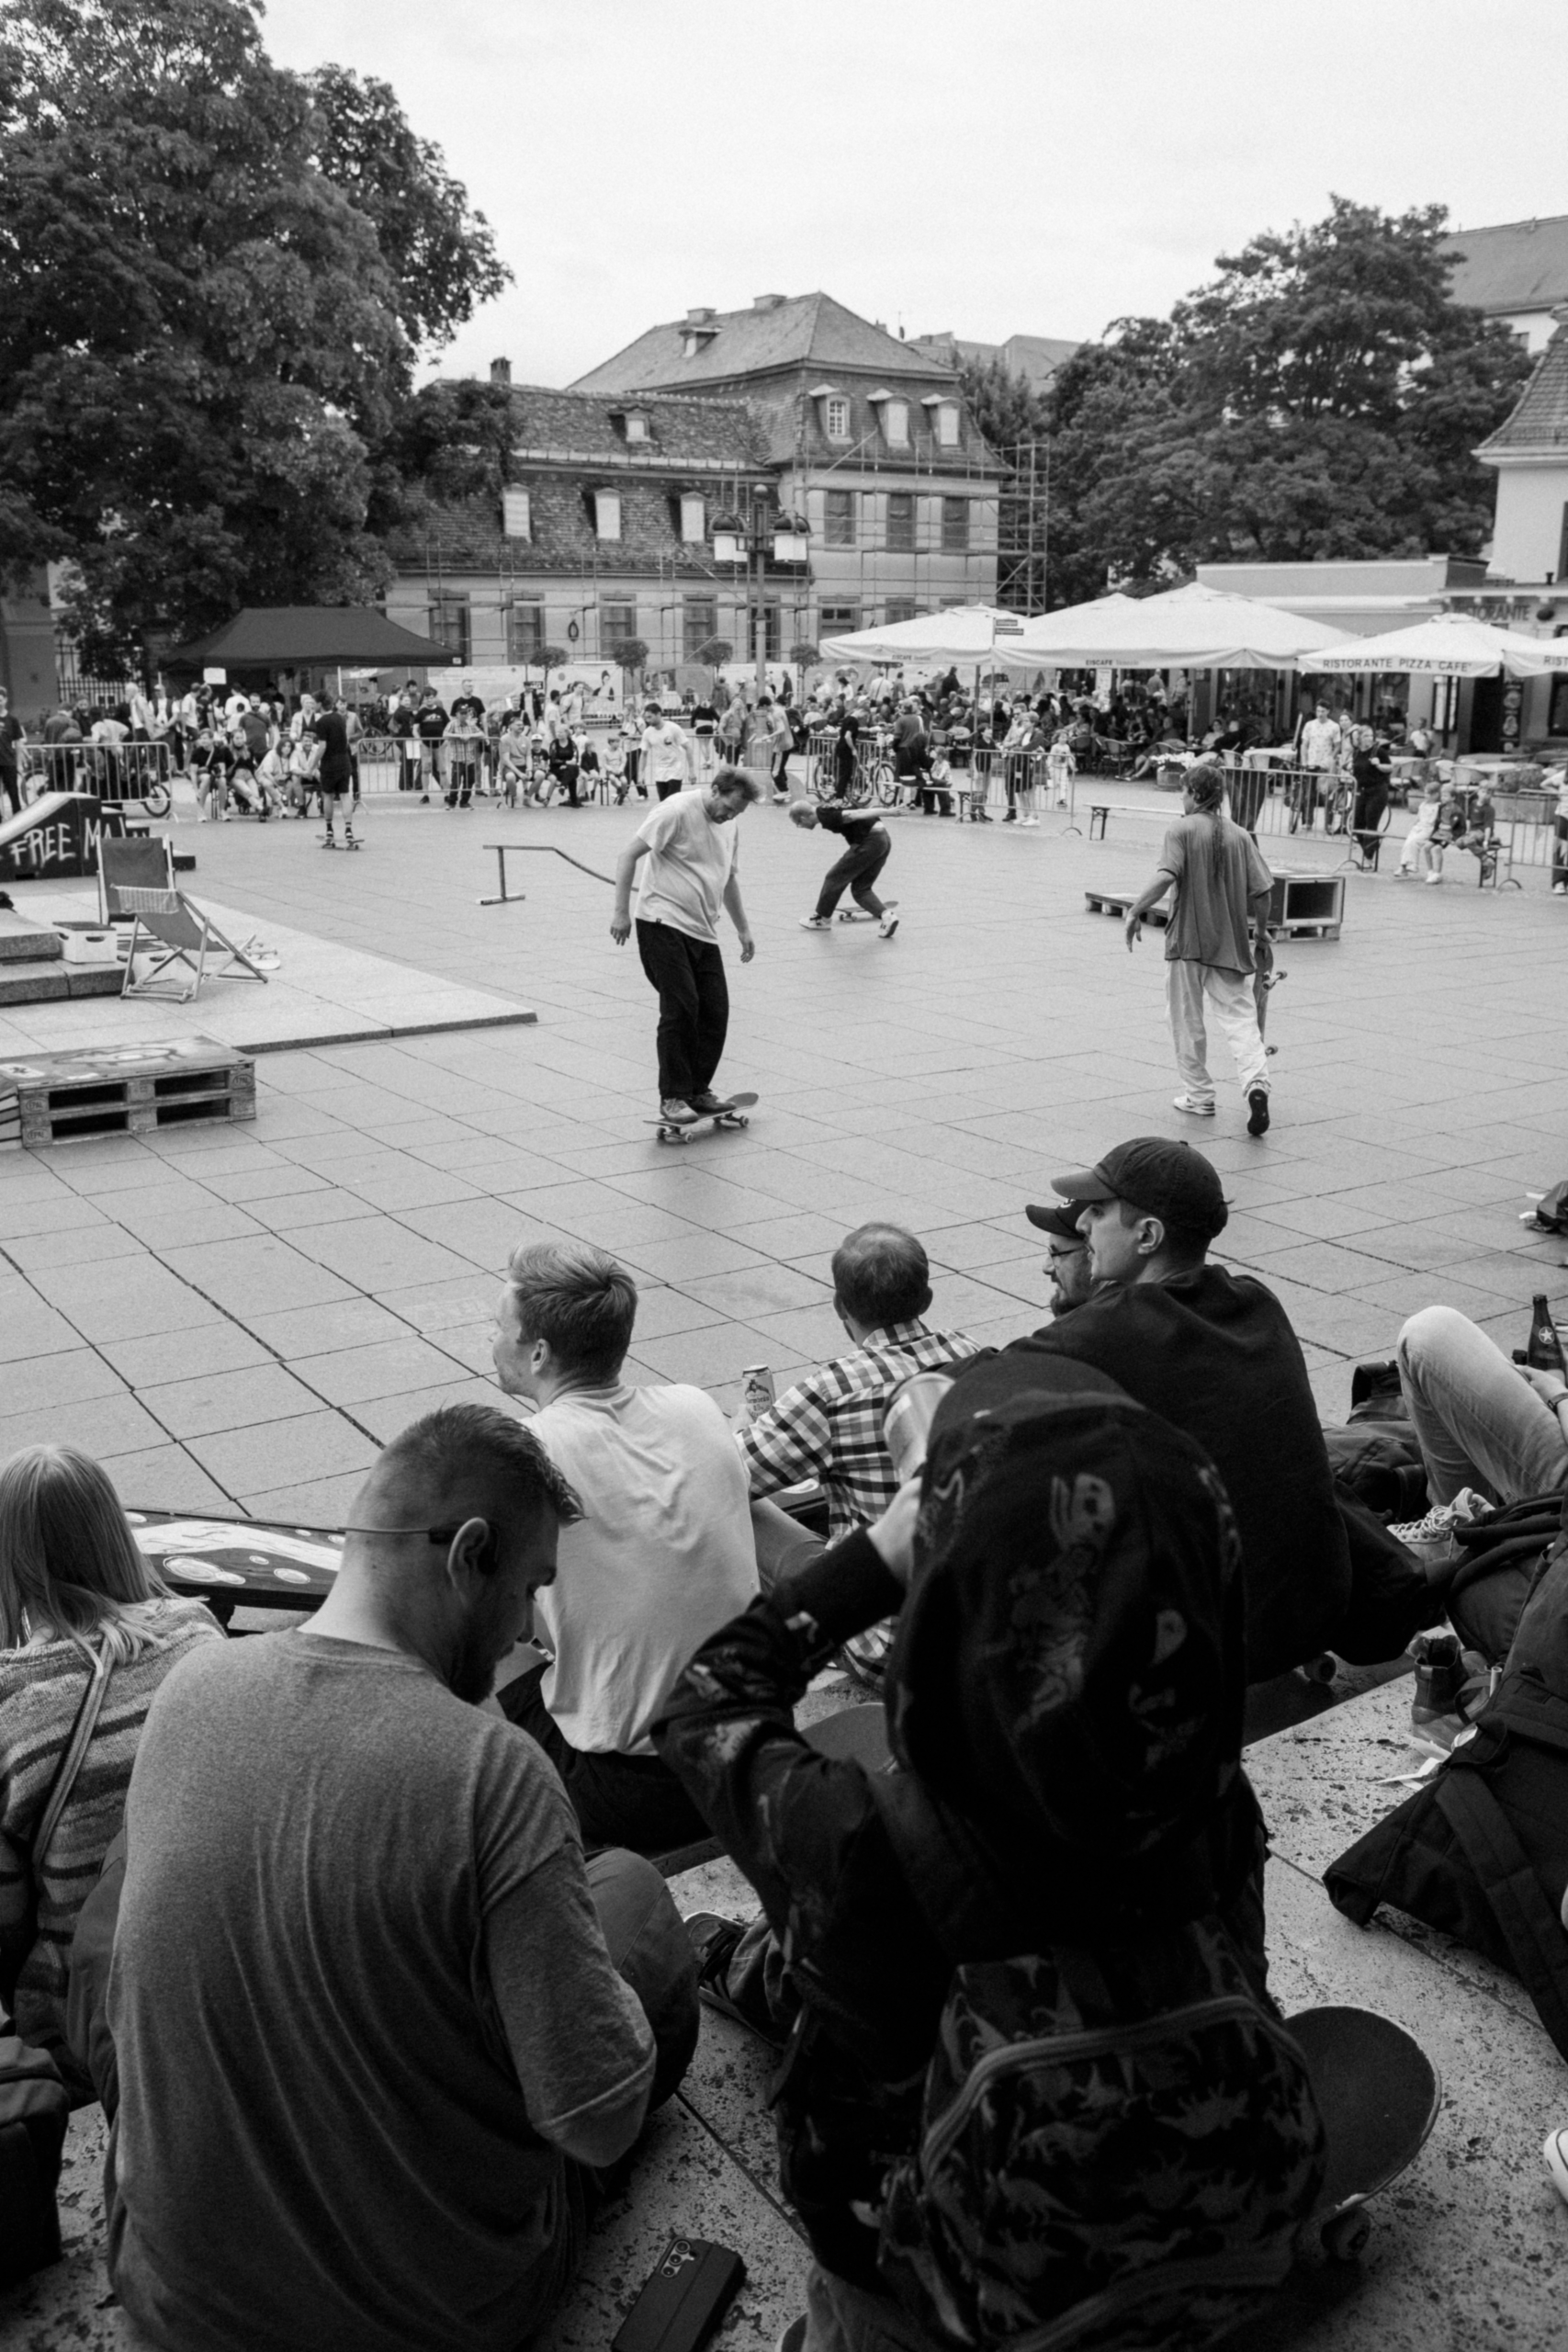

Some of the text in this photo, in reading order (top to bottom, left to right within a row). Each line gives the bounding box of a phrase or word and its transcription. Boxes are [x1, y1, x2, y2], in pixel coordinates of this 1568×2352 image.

[1323, 658, 1393, 669] RISTORANTE
[1399, 658, 1431, 670] PIZZA
[9, 822, 76, 868] FREE
